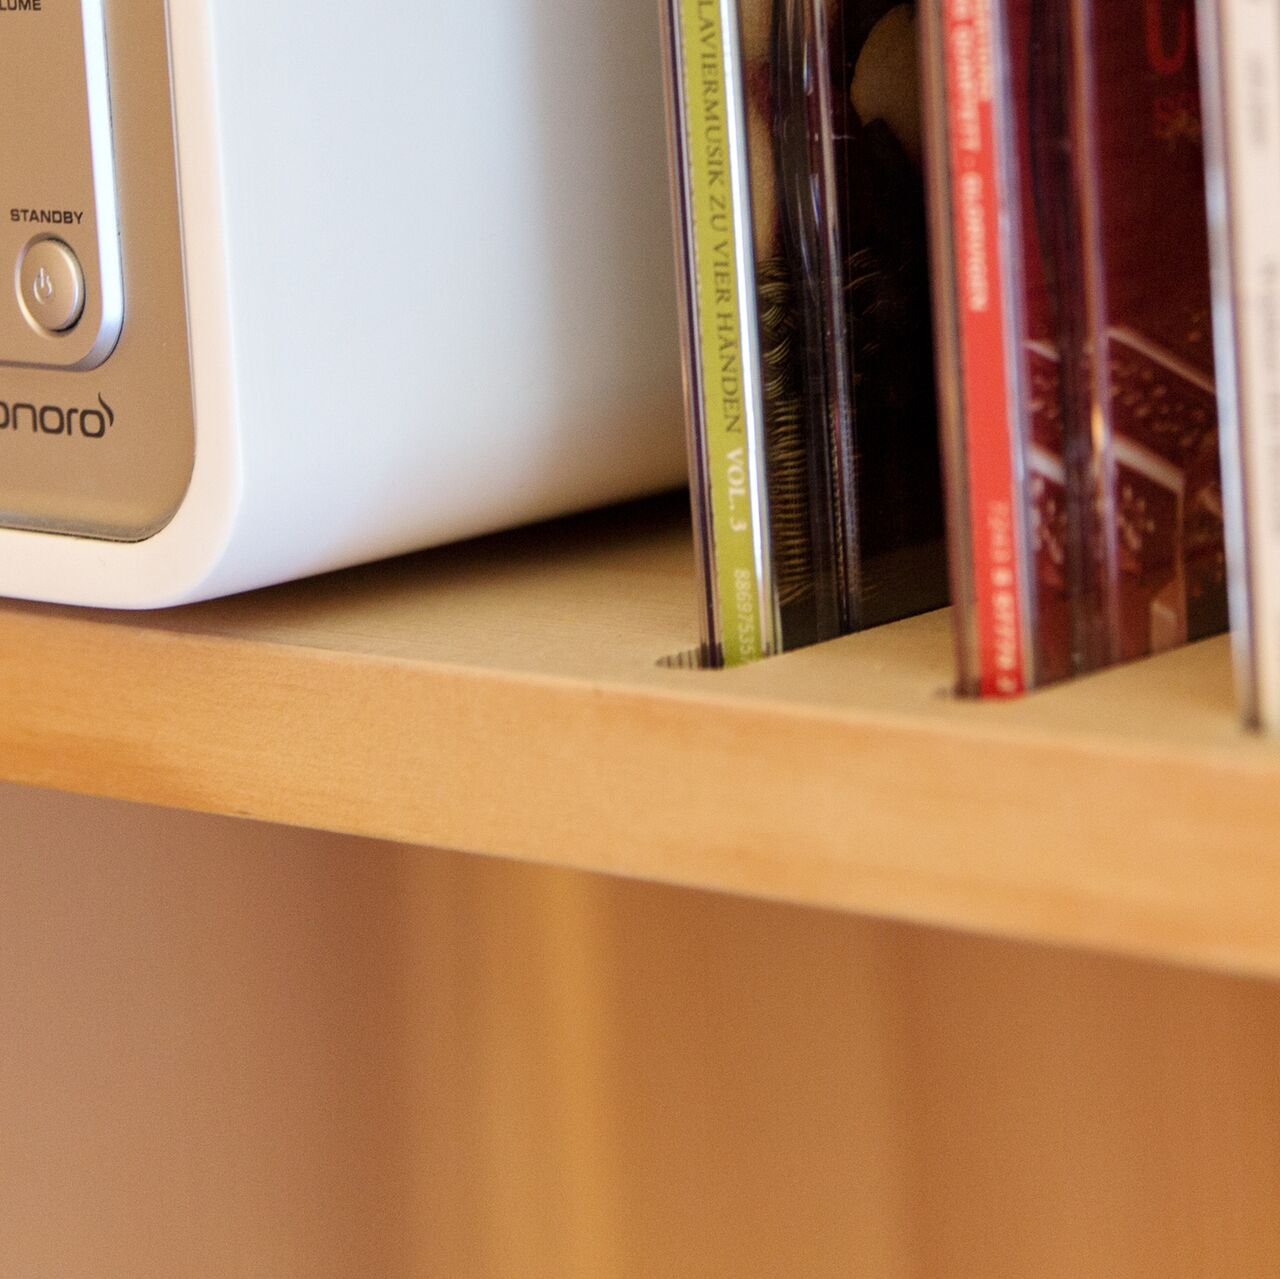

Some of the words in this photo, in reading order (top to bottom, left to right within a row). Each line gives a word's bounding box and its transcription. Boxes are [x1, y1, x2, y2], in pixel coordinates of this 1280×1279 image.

[10, 208, 84, 224] STANDBY
[709, 194, 729, 232] ZU
[712, 239, 733, 305] VIER
[725, 446, 747, 510] VOL.
[730, 517, 747, 533] 3
